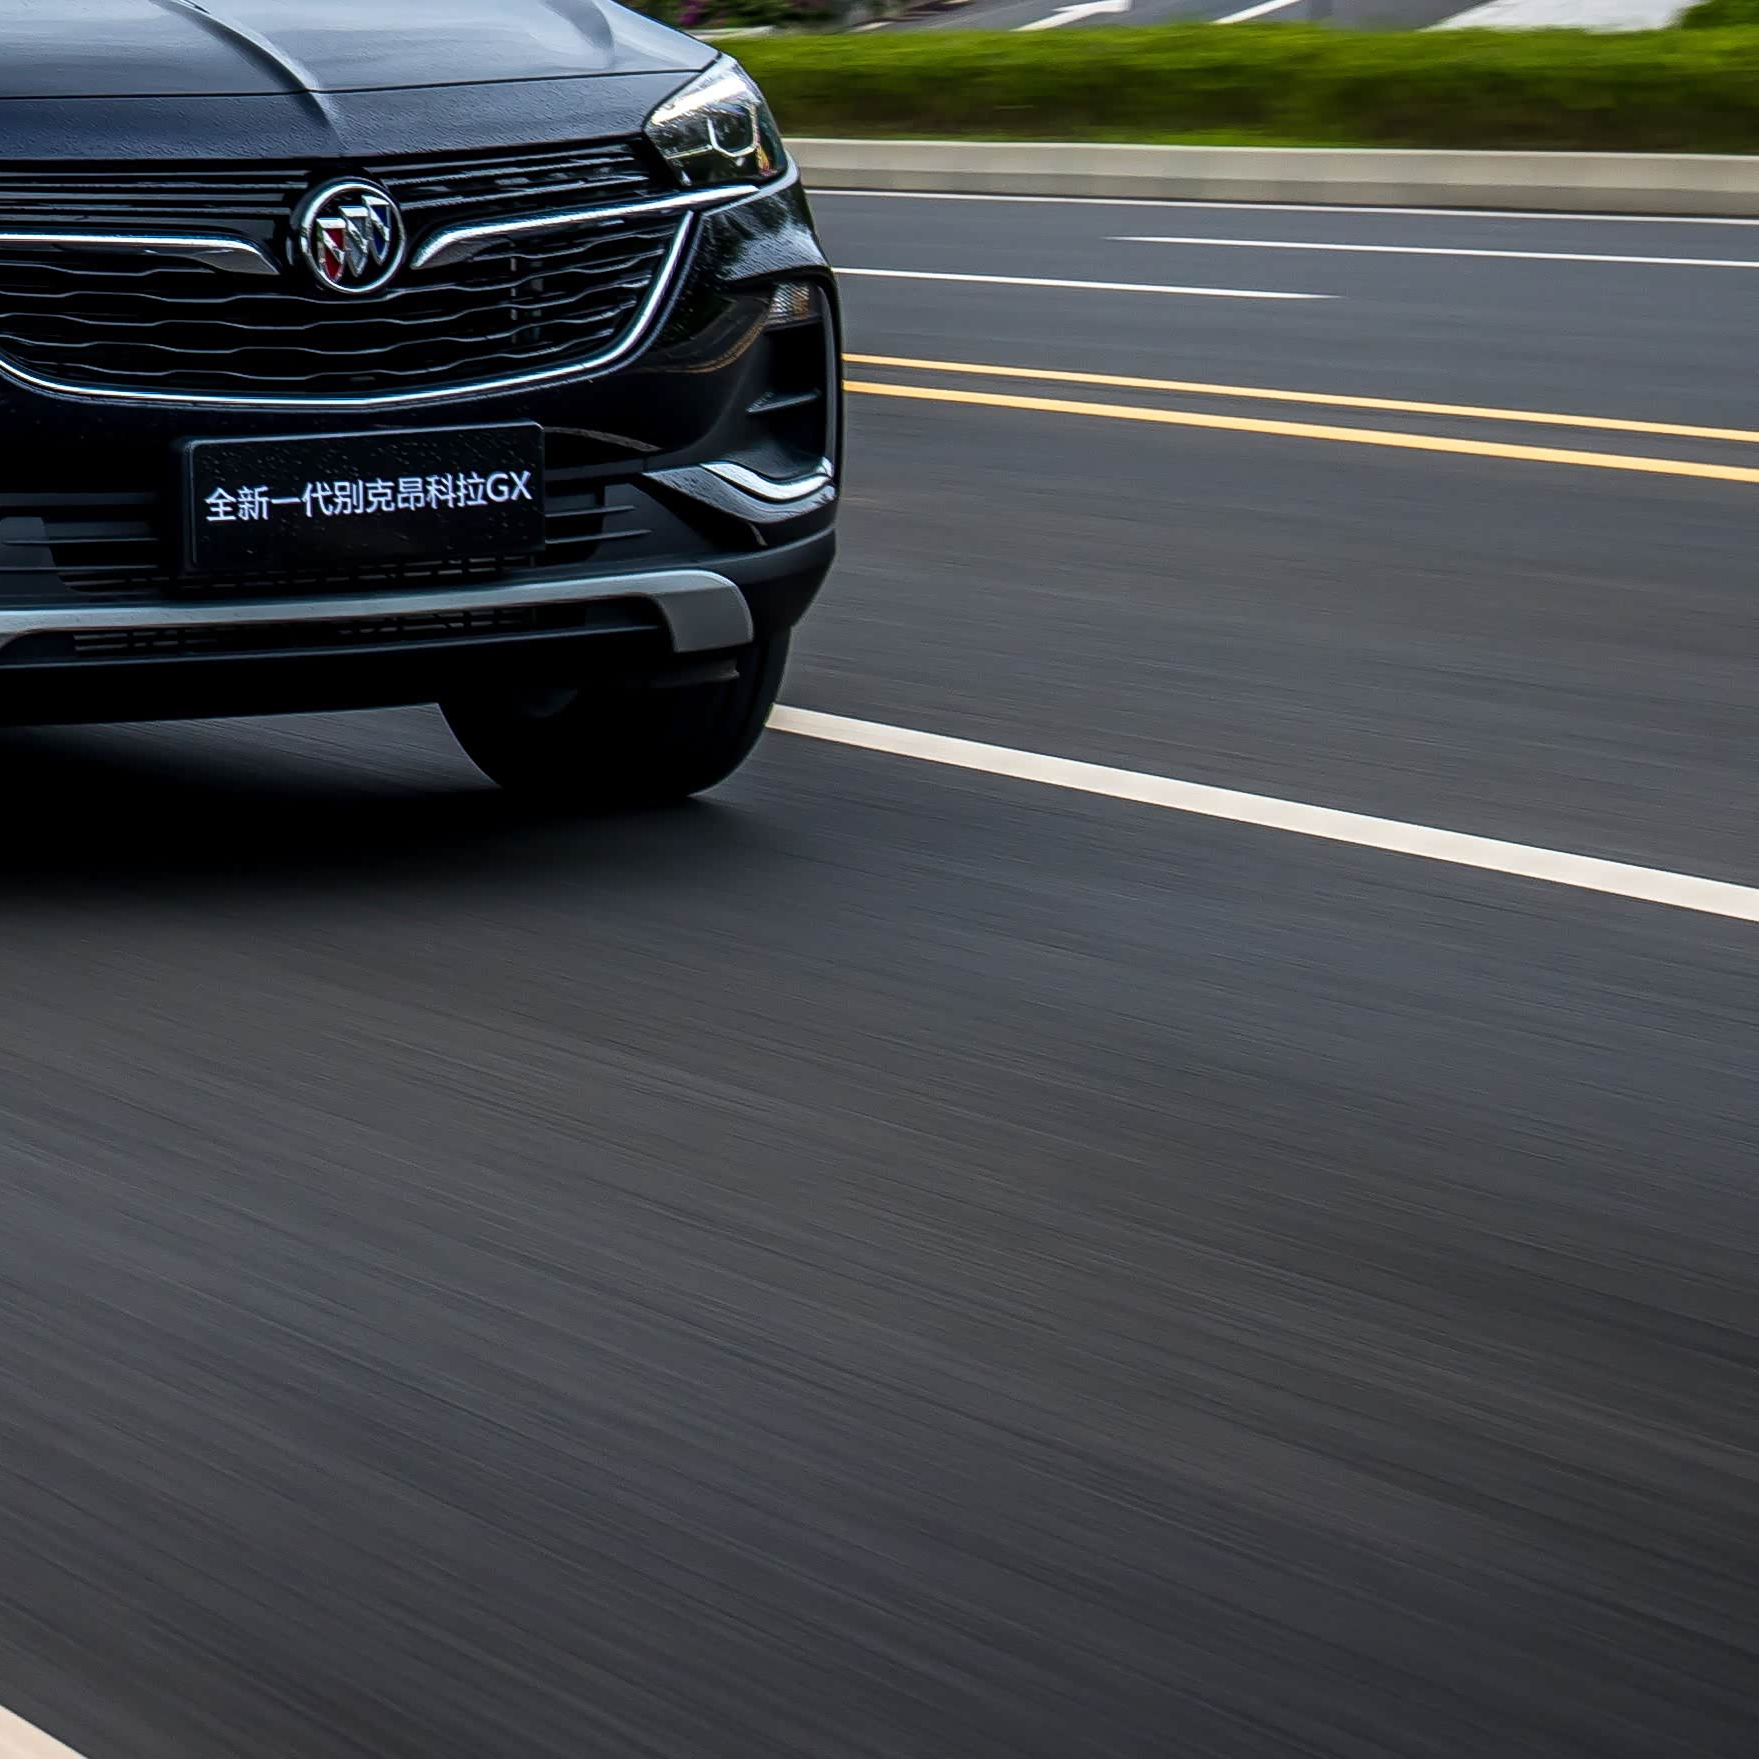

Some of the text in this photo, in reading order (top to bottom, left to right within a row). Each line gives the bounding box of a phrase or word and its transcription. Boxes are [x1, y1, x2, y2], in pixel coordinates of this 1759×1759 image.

[204, 470, 533, 522] 全新一代别克昂科拉GX
